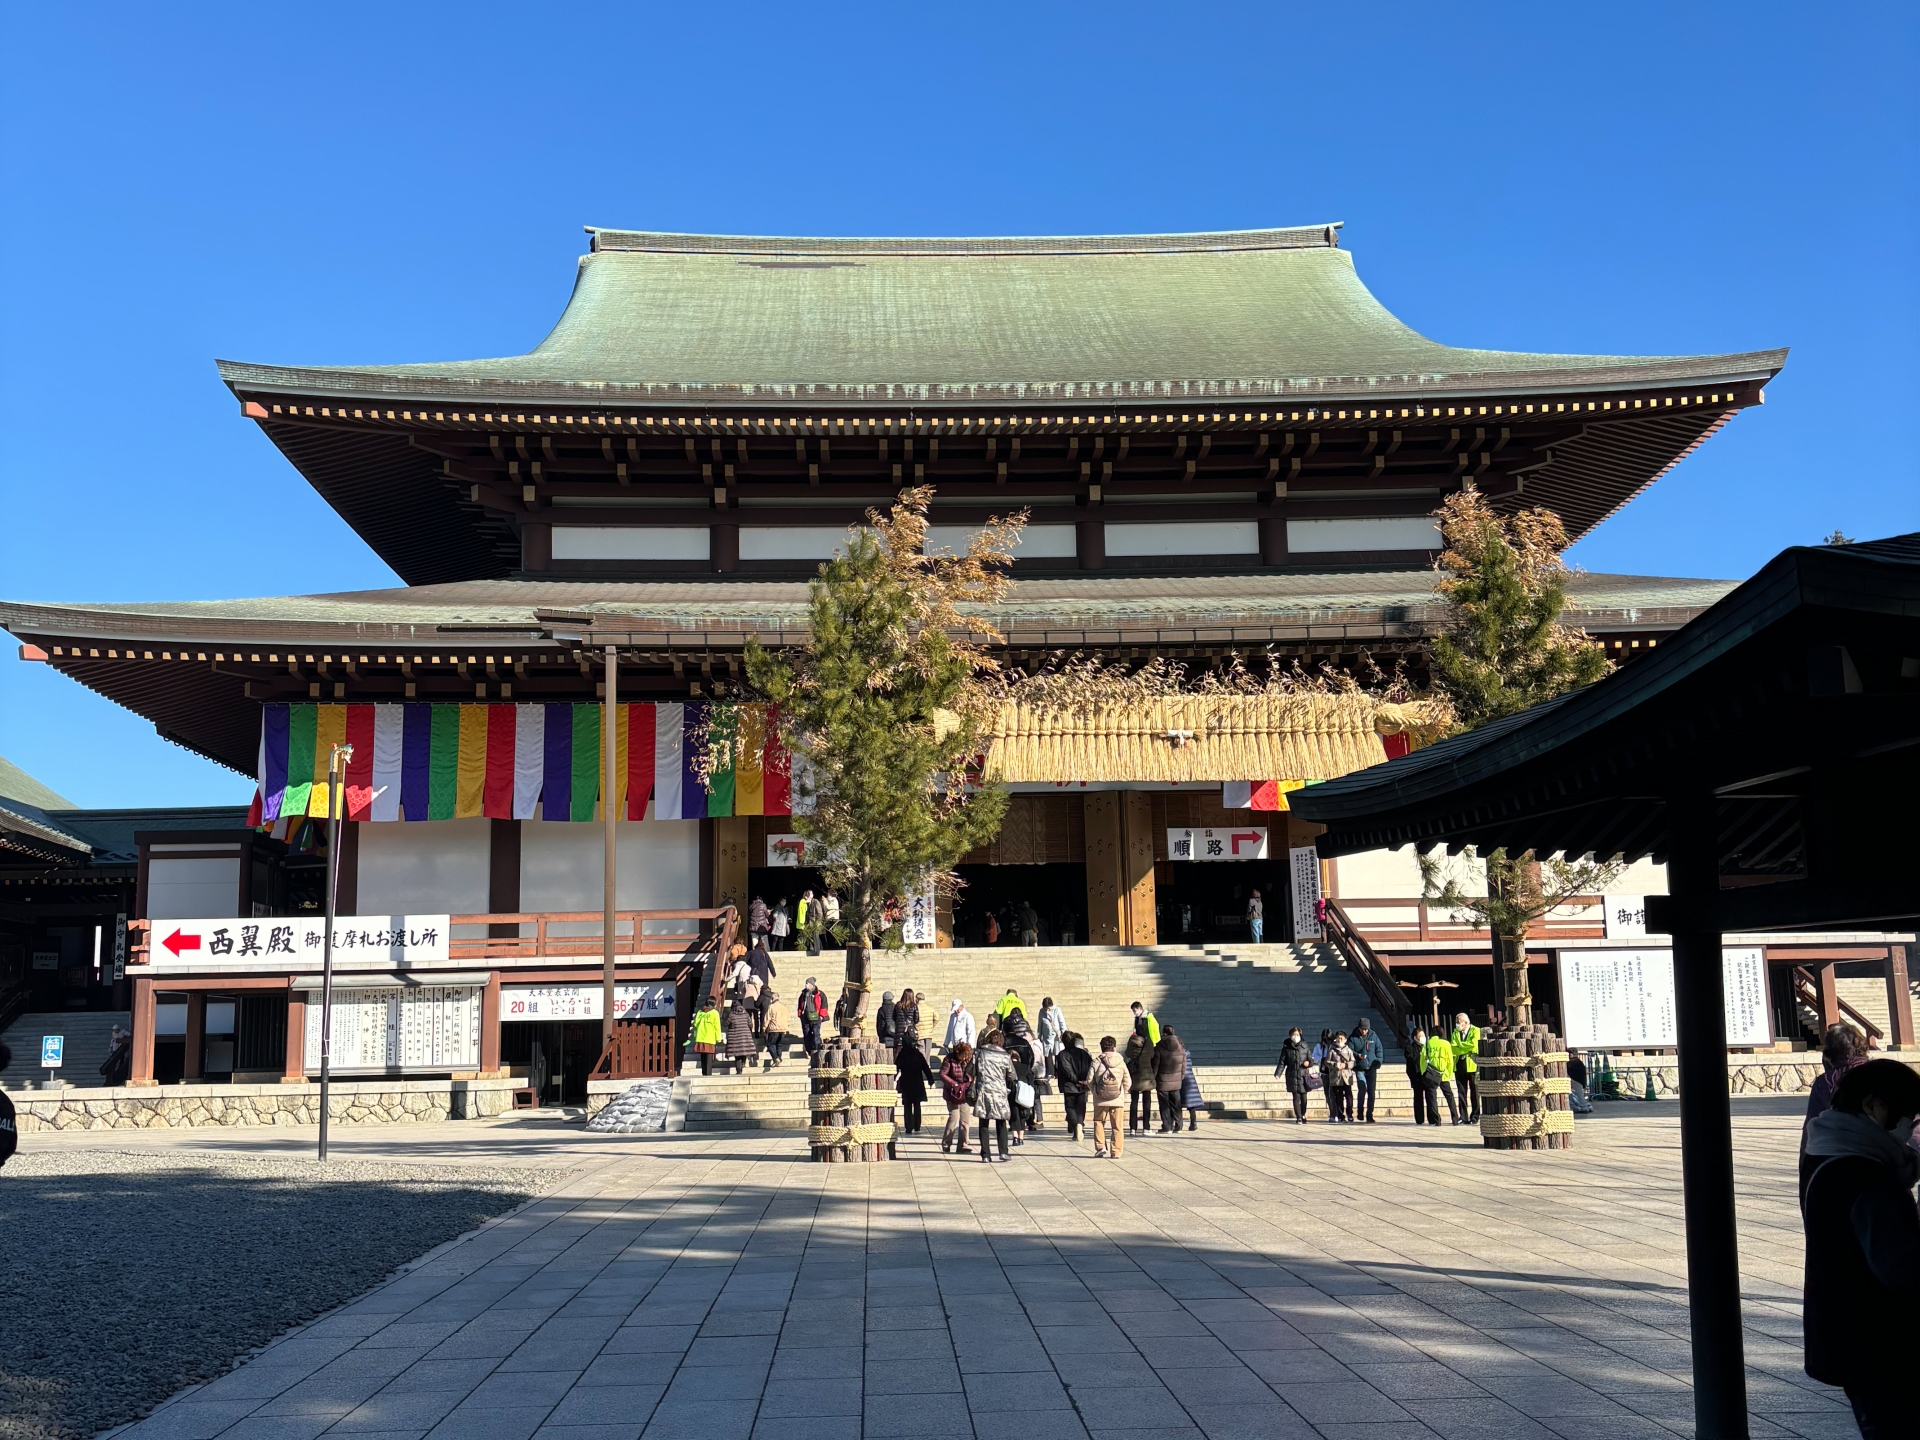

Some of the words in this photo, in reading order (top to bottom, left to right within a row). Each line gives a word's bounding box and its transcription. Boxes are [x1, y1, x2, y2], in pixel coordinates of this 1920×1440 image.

[1173, 839, 1223, 856] 順路
[114, 917, 126, 974] 御守札受場
[208, 925, 296, 957] 西翼殿
